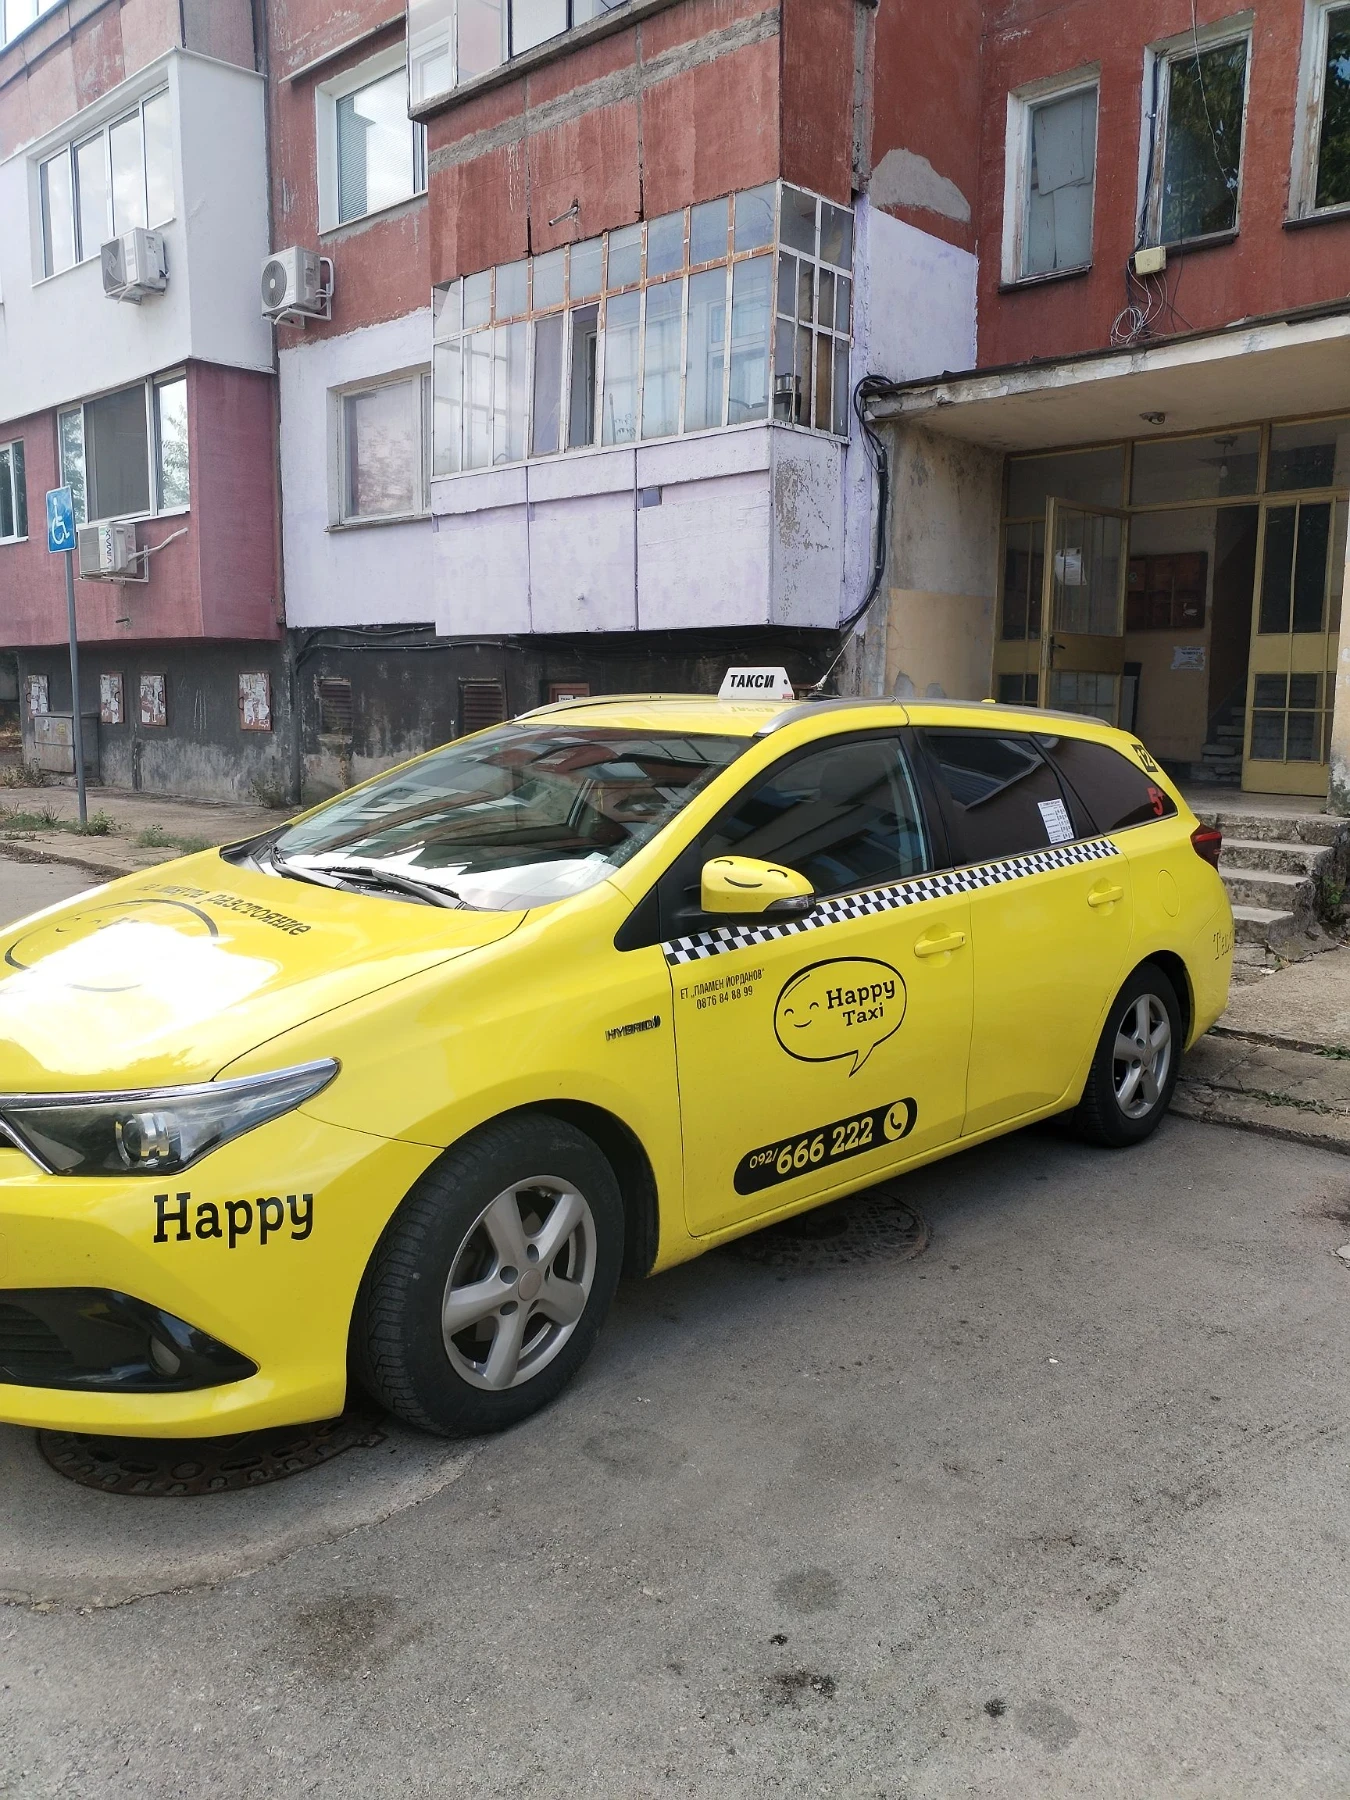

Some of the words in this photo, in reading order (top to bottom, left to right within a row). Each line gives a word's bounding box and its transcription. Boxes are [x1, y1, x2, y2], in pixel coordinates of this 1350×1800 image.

[730, 674, 775, 688] ТАКСИ
[680, 988, 689, 999] ЕТ
[696, 995, 717, 1009] 0876
[719, 992, 729, 1003] 84
[731, 989, 742, 1000] 88
[743, 986, 753, 997] 99
[826, 980, 895, 1010] Happy
[842, 1002, 884, 1026] Taxi
[830, 1116, 874, 1156] 222
[153, 1192, 313, 1249] Happy
